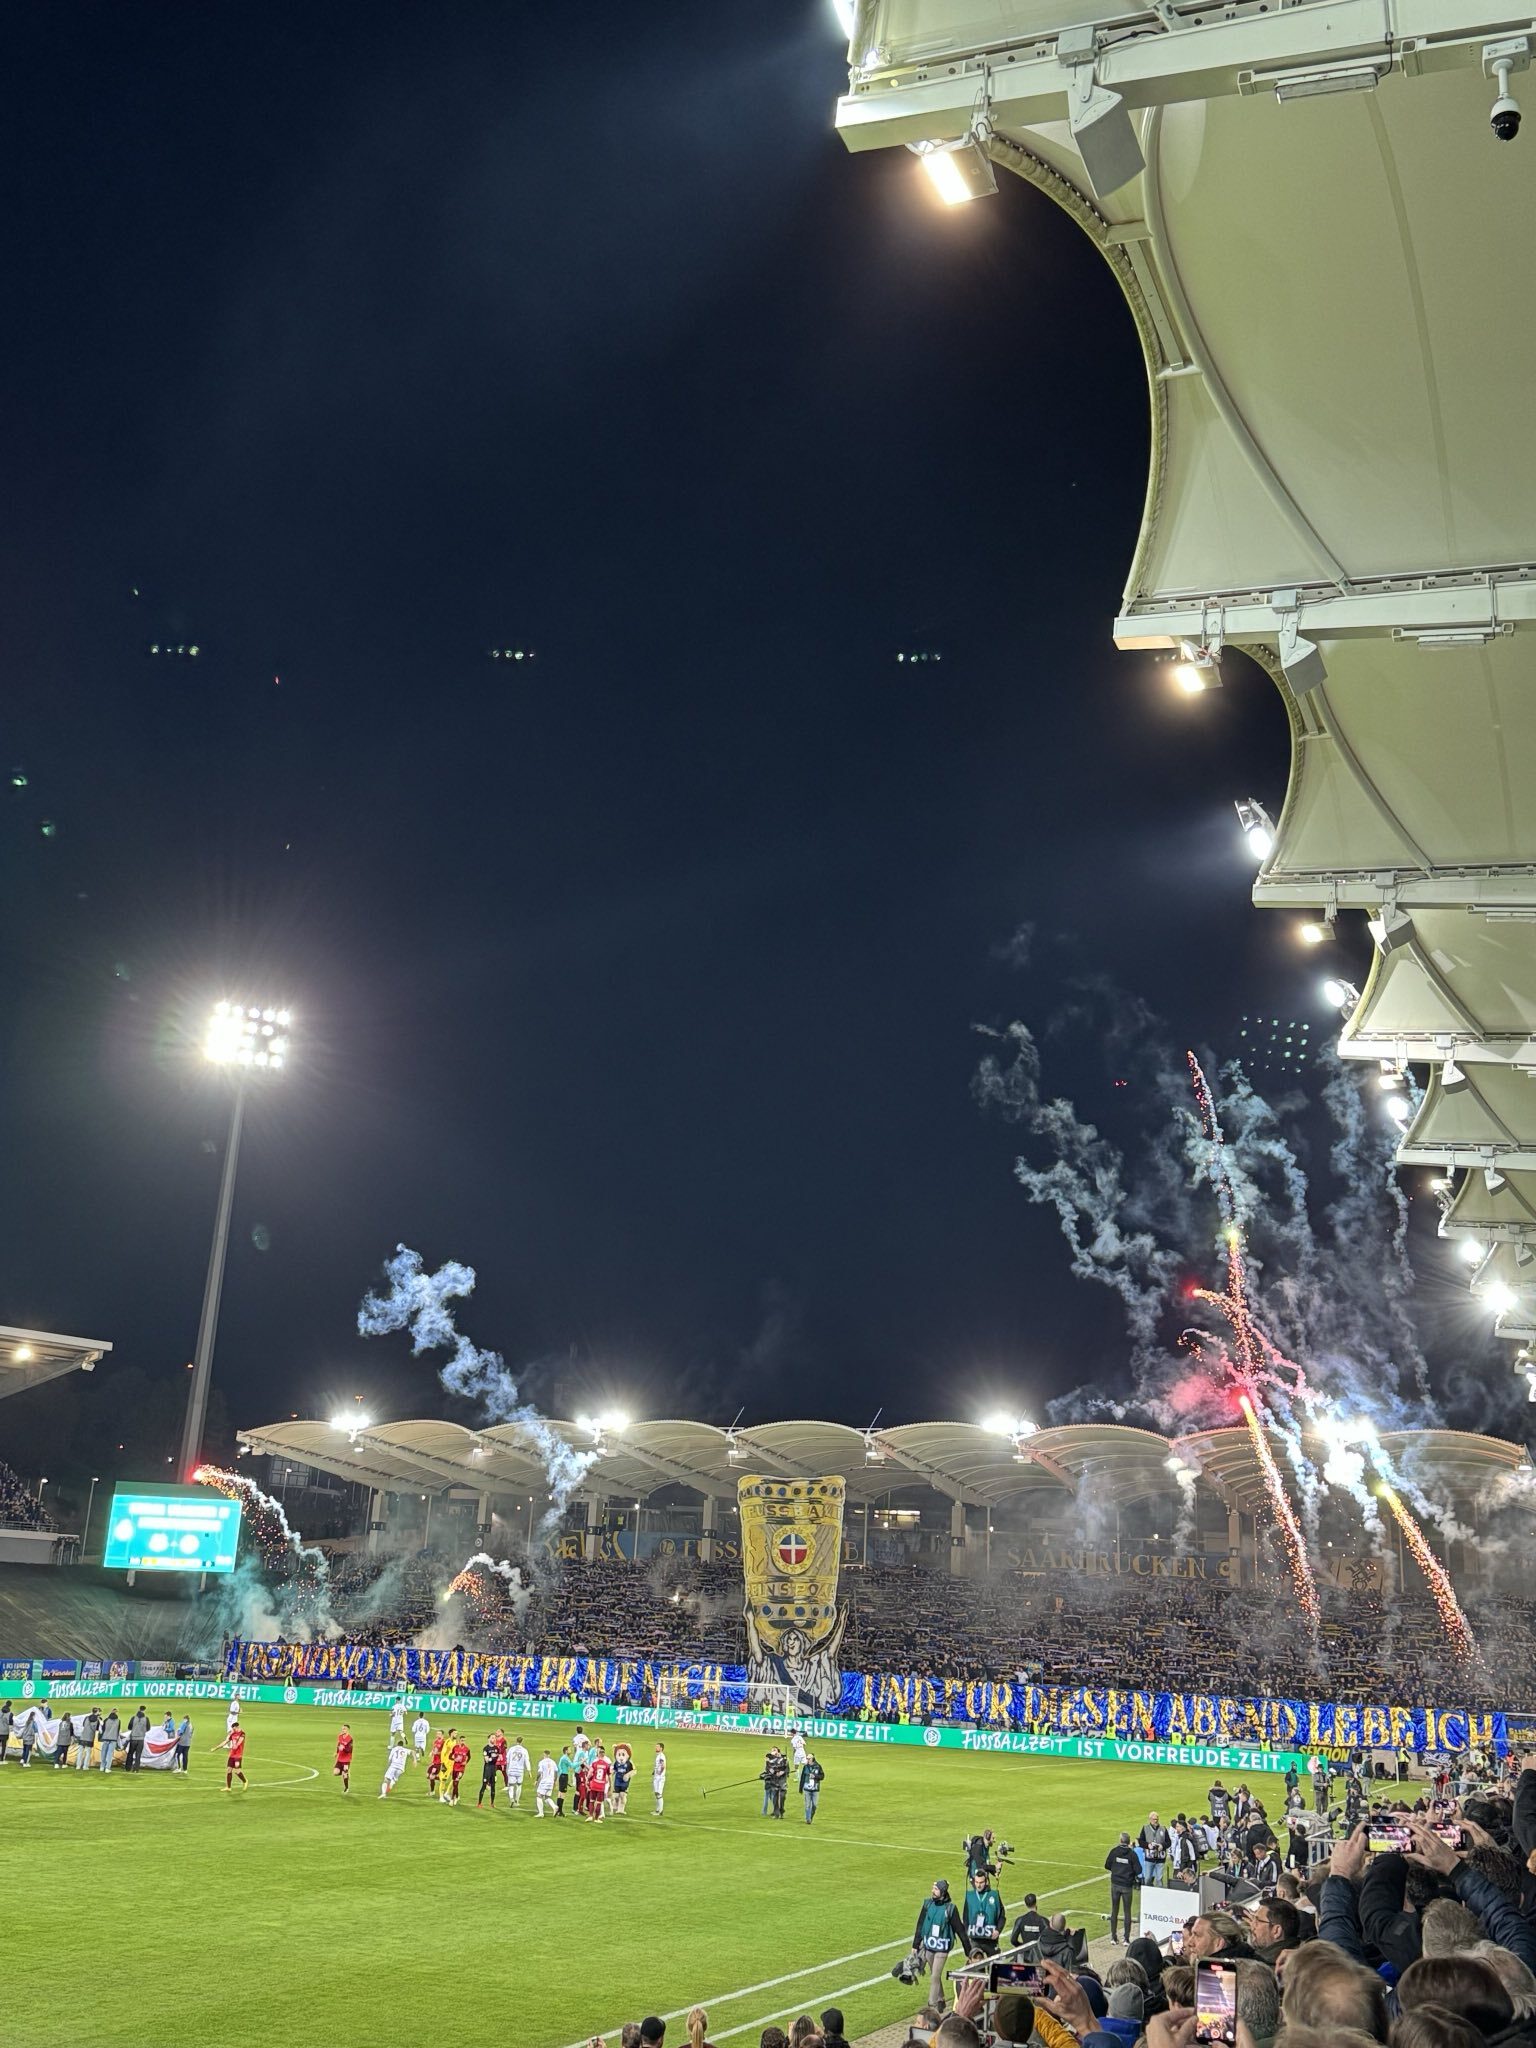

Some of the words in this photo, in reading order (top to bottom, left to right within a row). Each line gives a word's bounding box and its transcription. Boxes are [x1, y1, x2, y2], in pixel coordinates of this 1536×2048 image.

[121, 1682, 139, 1697] IST
[143, 1682, 262, 1700] VORFREUDE-ZEIT.
[400, 1696, 424, 1710] IST
[430, 1697, 557, 1718] VORFREUDE-ZEIT.
[716, 1715, 741, 1728] IST
[1425, 1707, 1494, 1752] ICH
[1078, 1740, 1105, 1757] IST
[1114, 1744, 1285, 1771] VORFREUDE-ZEIT.
[1299, 1745, 1350, 1763] SEKTION
